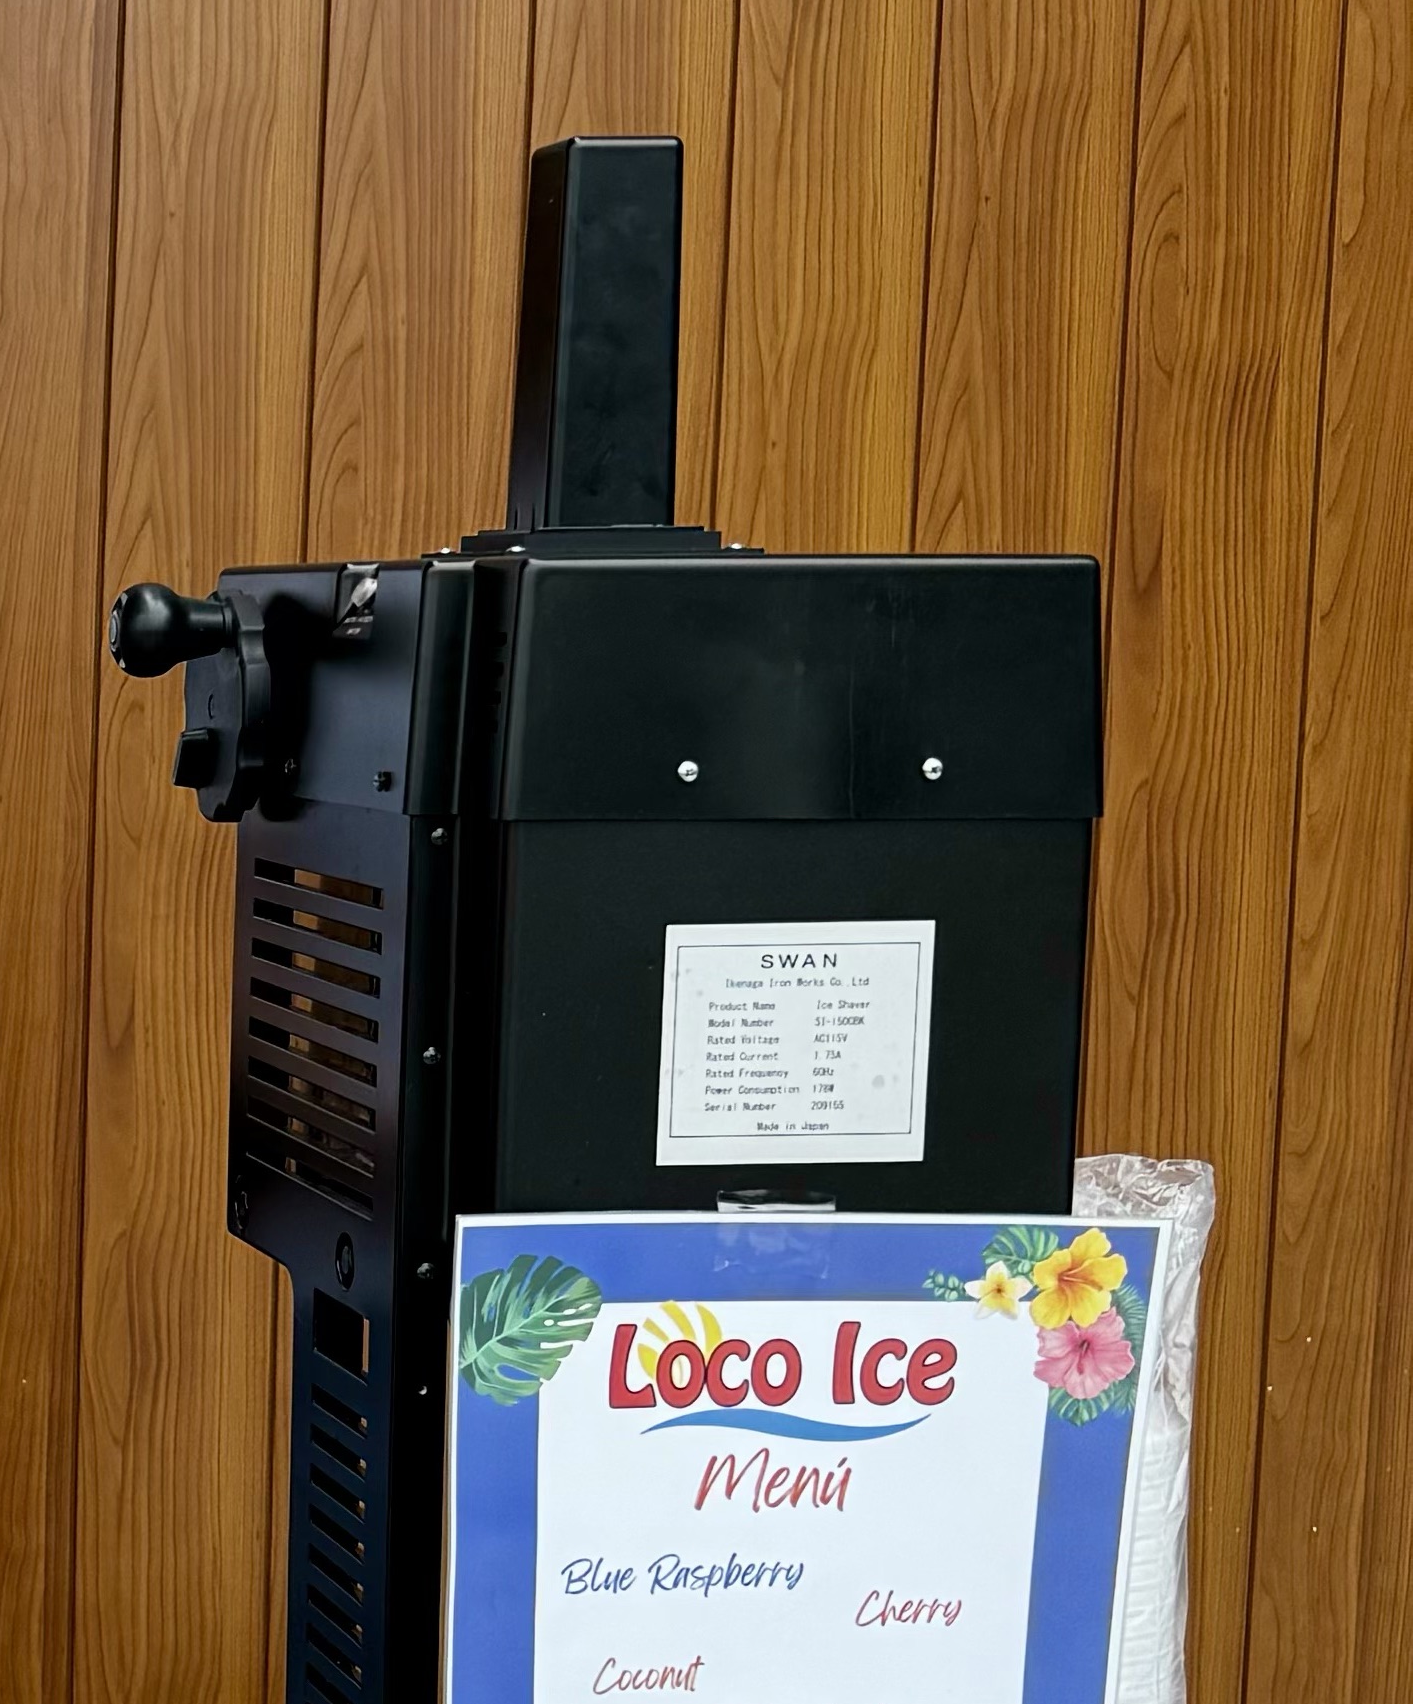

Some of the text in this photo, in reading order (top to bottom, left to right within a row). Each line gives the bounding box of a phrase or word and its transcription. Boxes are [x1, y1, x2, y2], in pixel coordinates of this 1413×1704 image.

[760, 953, 838, 969] SWAN
[769, 979, 791, 987] Iron
[796, 978, 824, 987] Works
[709, 1001, 776, 1011] Product Name
[817, 1000, 870, 1009] Ice Shaver
[708, 1018, 774, 1027] Model Number
[707, 1035, 780, 1045] Rated Voltage
[706, 1052, 779, 1061] Rated Current
[706, 1069, 788, 1079] Rated Frequency
[705, 1085, 800, 1095] Power Consumption
[705, 1102, 776, 1111] Serial Number
[757, 1121, 829, 1131] Made in Japan
[608, 1321, 958, 1408] Loco Ice
[561, 1553, 804, 1597] Blue Raspberry
[855, 1590, 963, 1627] Cherry
[593, 1655, 705, 1695] Coconut
